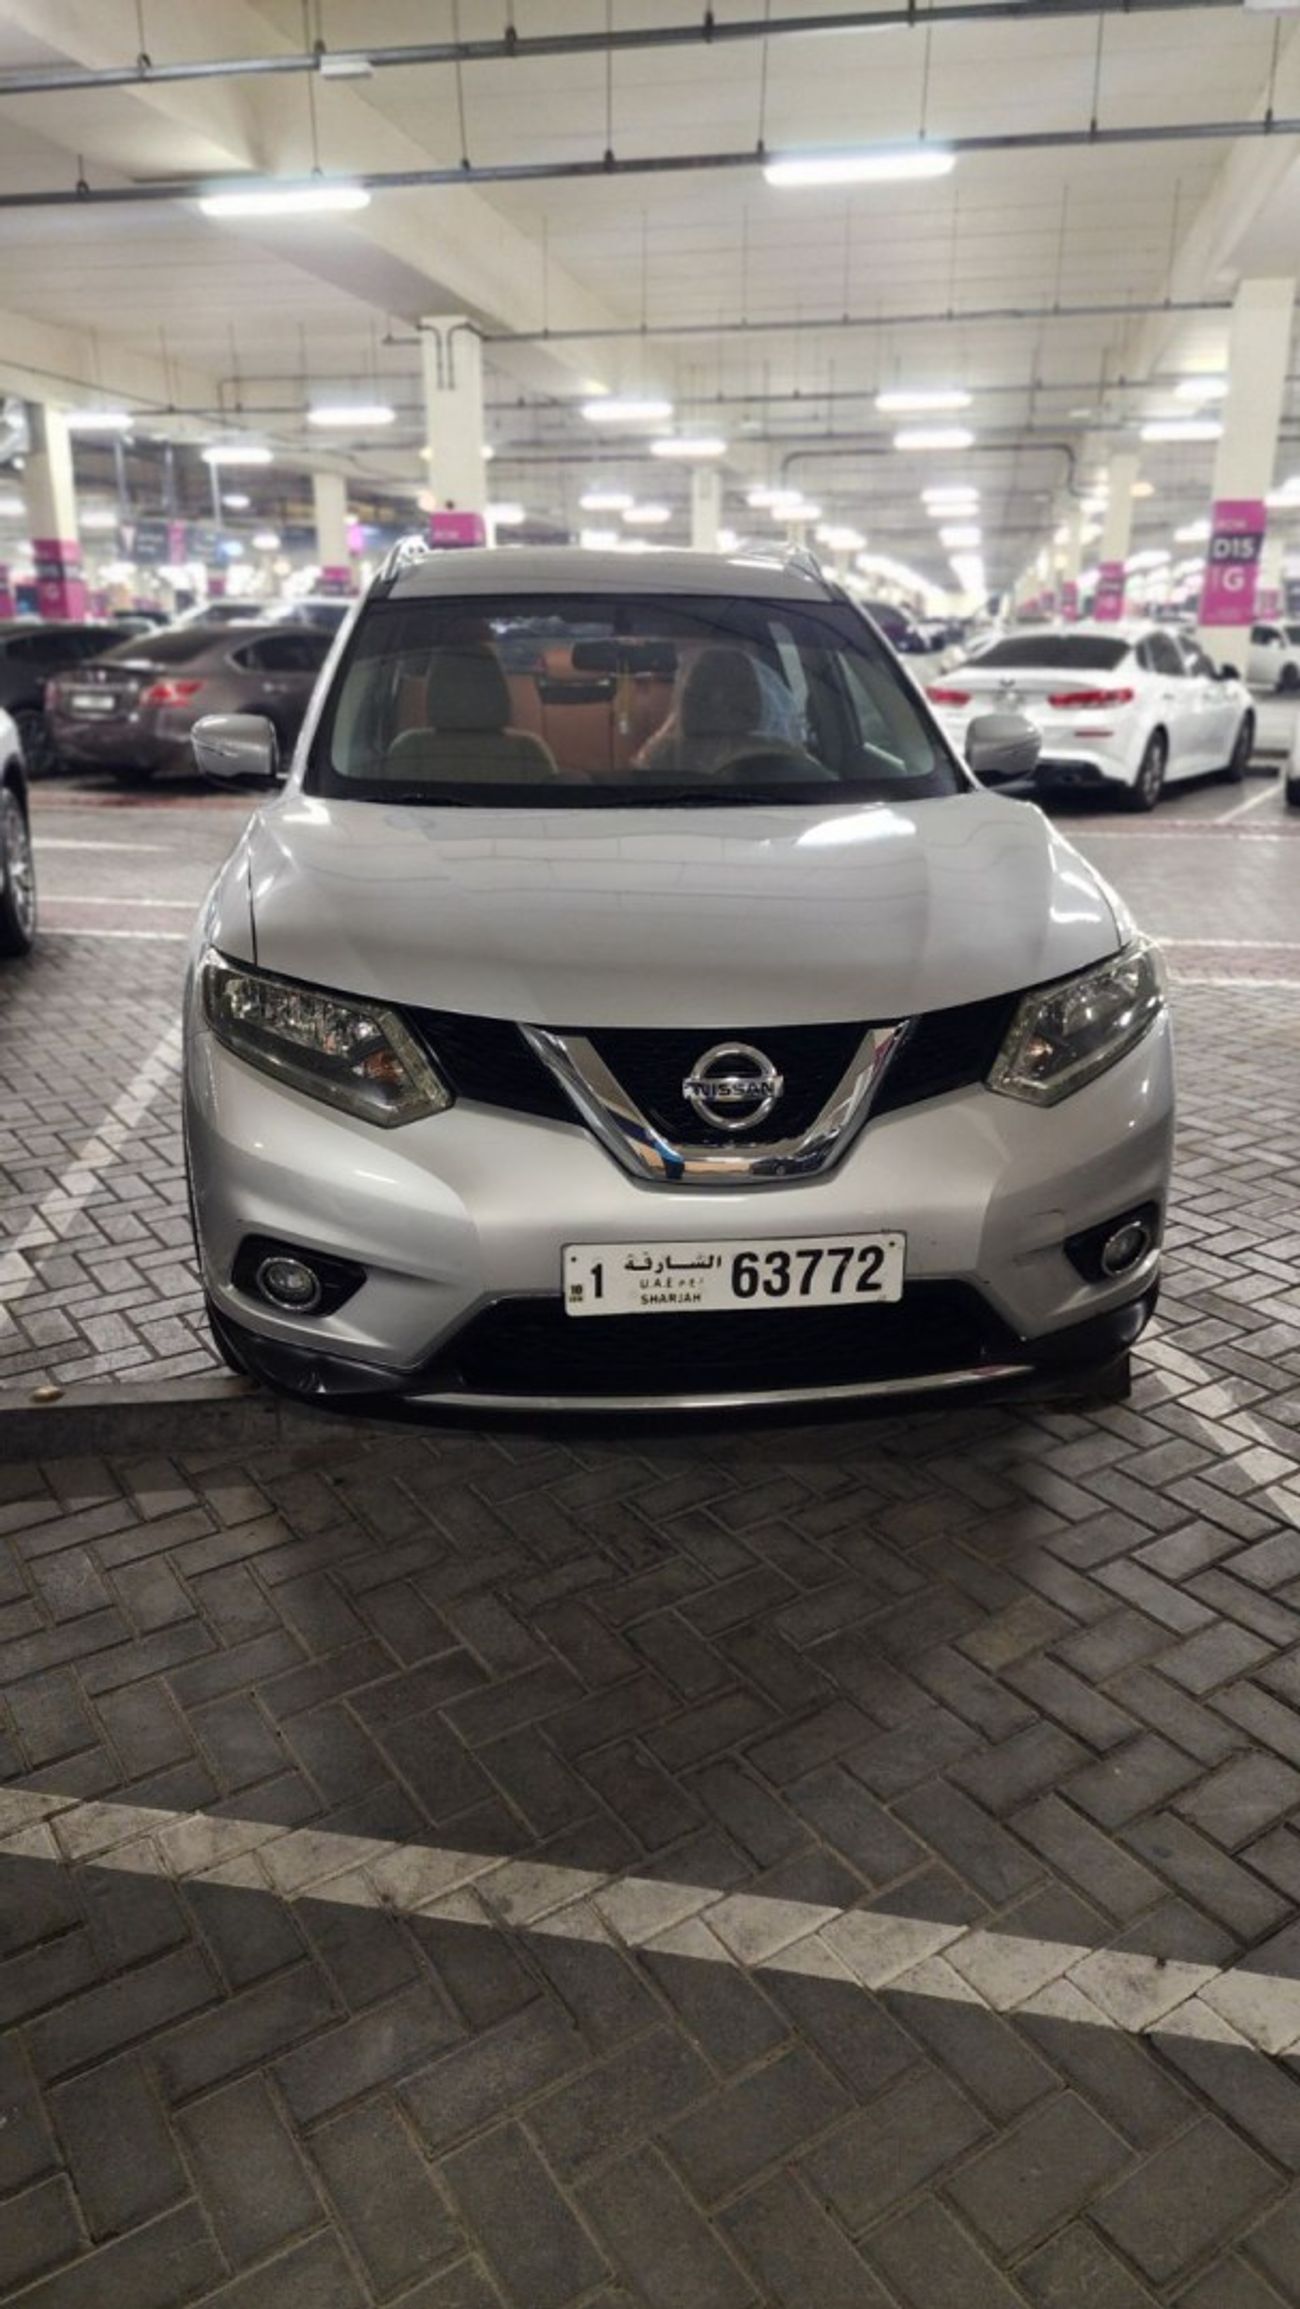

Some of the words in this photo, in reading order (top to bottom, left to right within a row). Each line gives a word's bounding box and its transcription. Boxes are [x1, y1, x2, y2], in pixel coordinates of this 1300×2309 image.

[1213, 538, 1254, 559] D15
[1223, 566, 1245, 592] G
[691, 1081, 776, 1098] NISSAN
[624, 1251, 722, 1274] الشارقة
[731, 1244, 885, 1298] 63772
[590, 1263, 604, 1299] 1
[640, 1292, 701, 1305] SHARJAH
